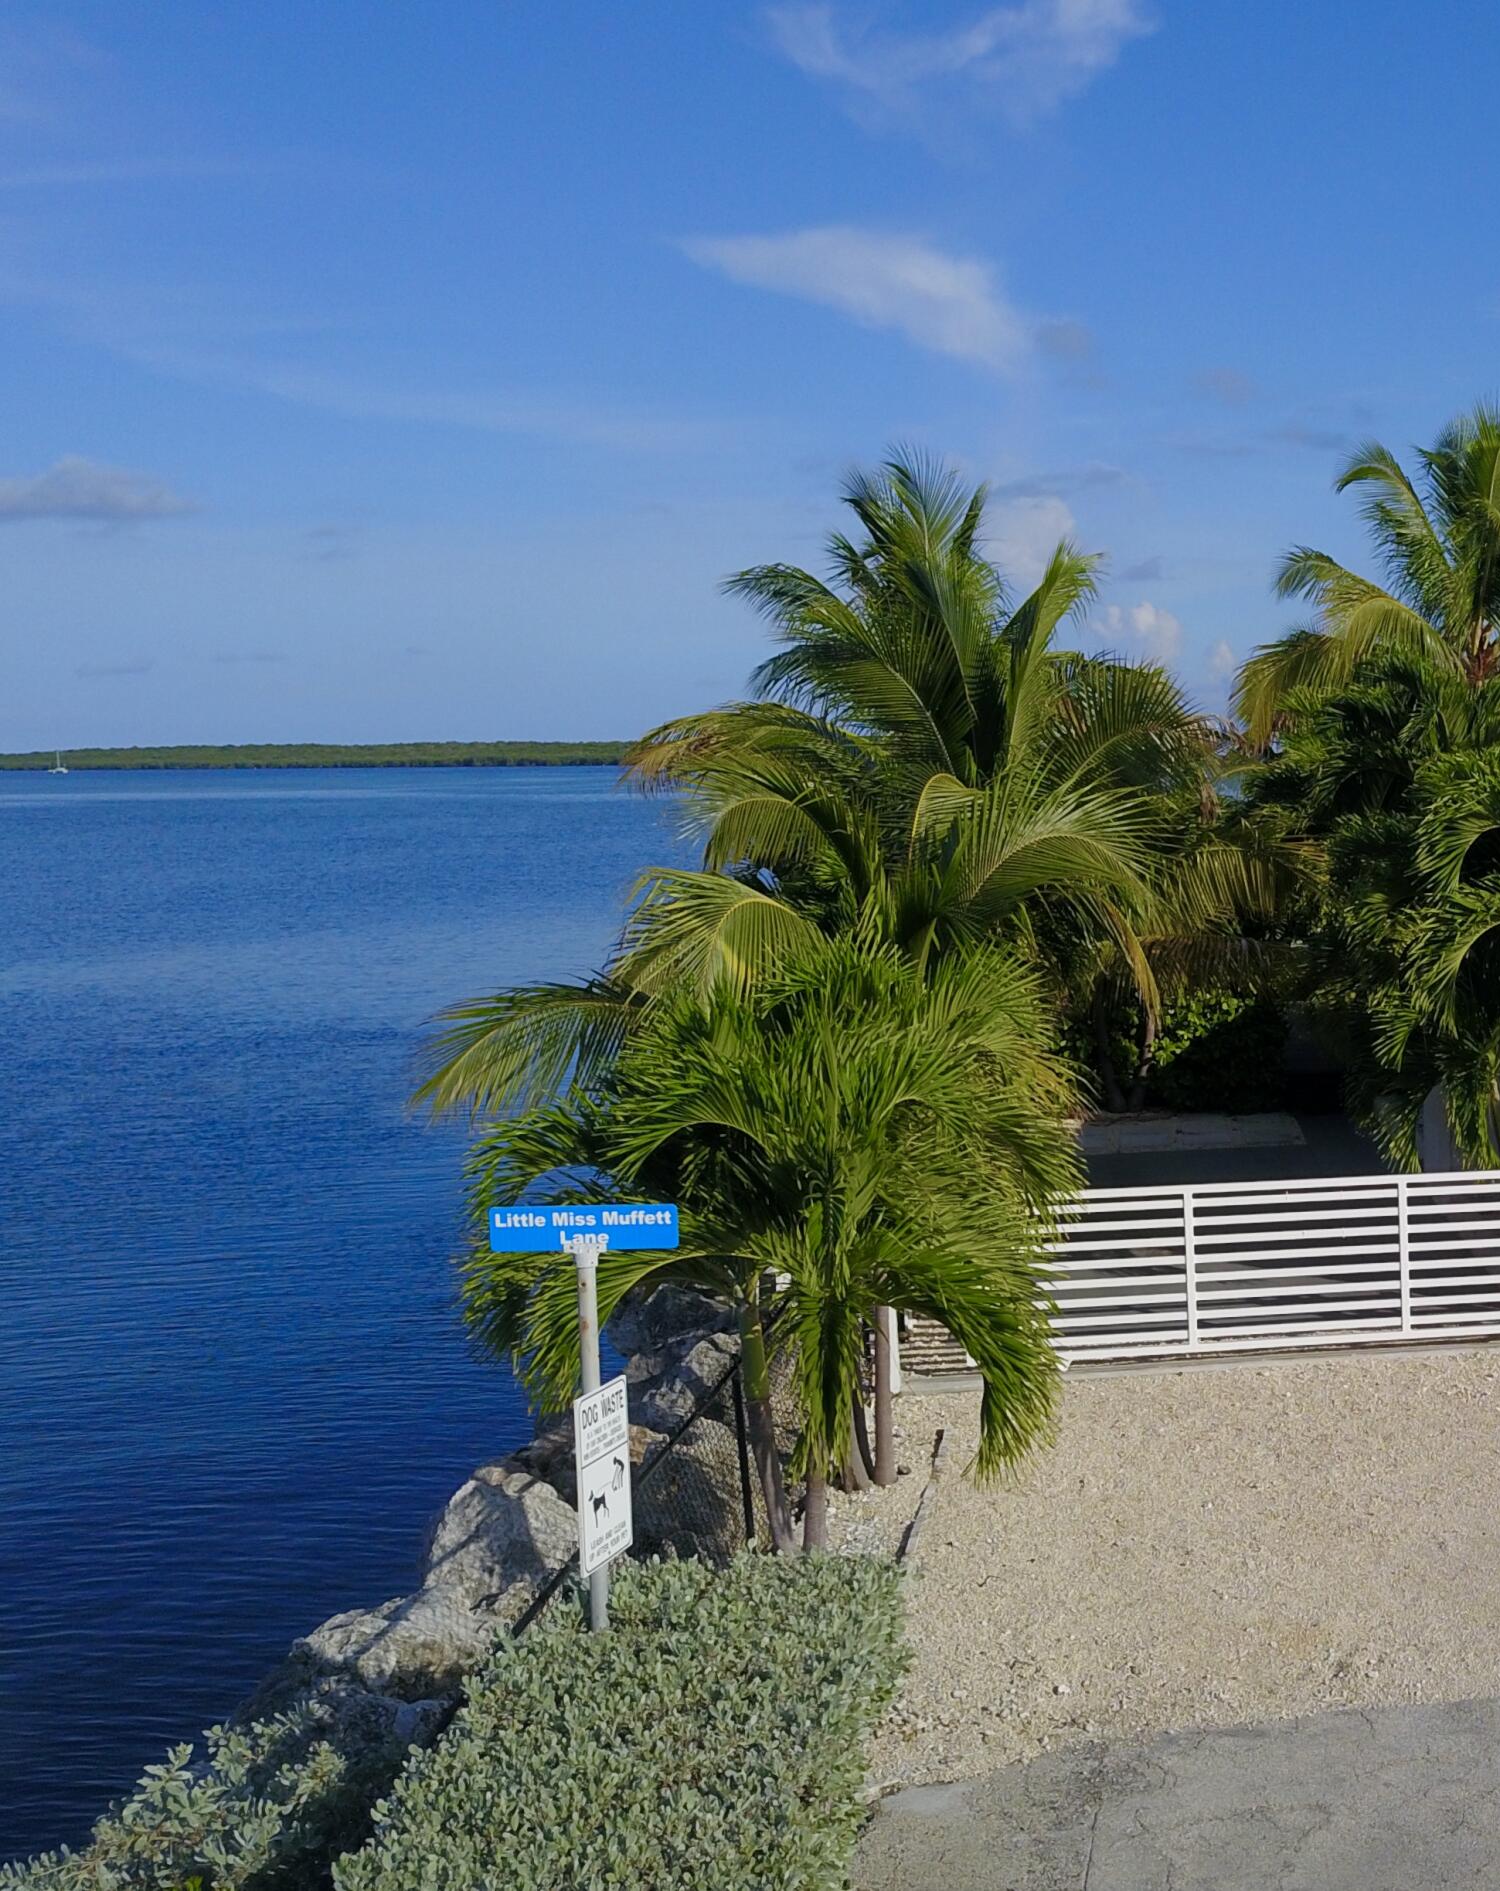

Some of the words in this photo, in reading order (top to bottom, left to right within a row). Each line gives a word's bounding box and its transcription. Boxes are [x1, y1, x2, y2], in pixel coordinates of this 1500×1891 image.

[495, 1213, 546, 1228] Little
[552, 1212, 596, 1227] Miss
[602, 1210, 672, 1226] Muffett
[560, 1231, 609, 1245] Lane
[582, 1404, 598, 1430] DOG
[601, 1389, 624, 1418] WASTE
